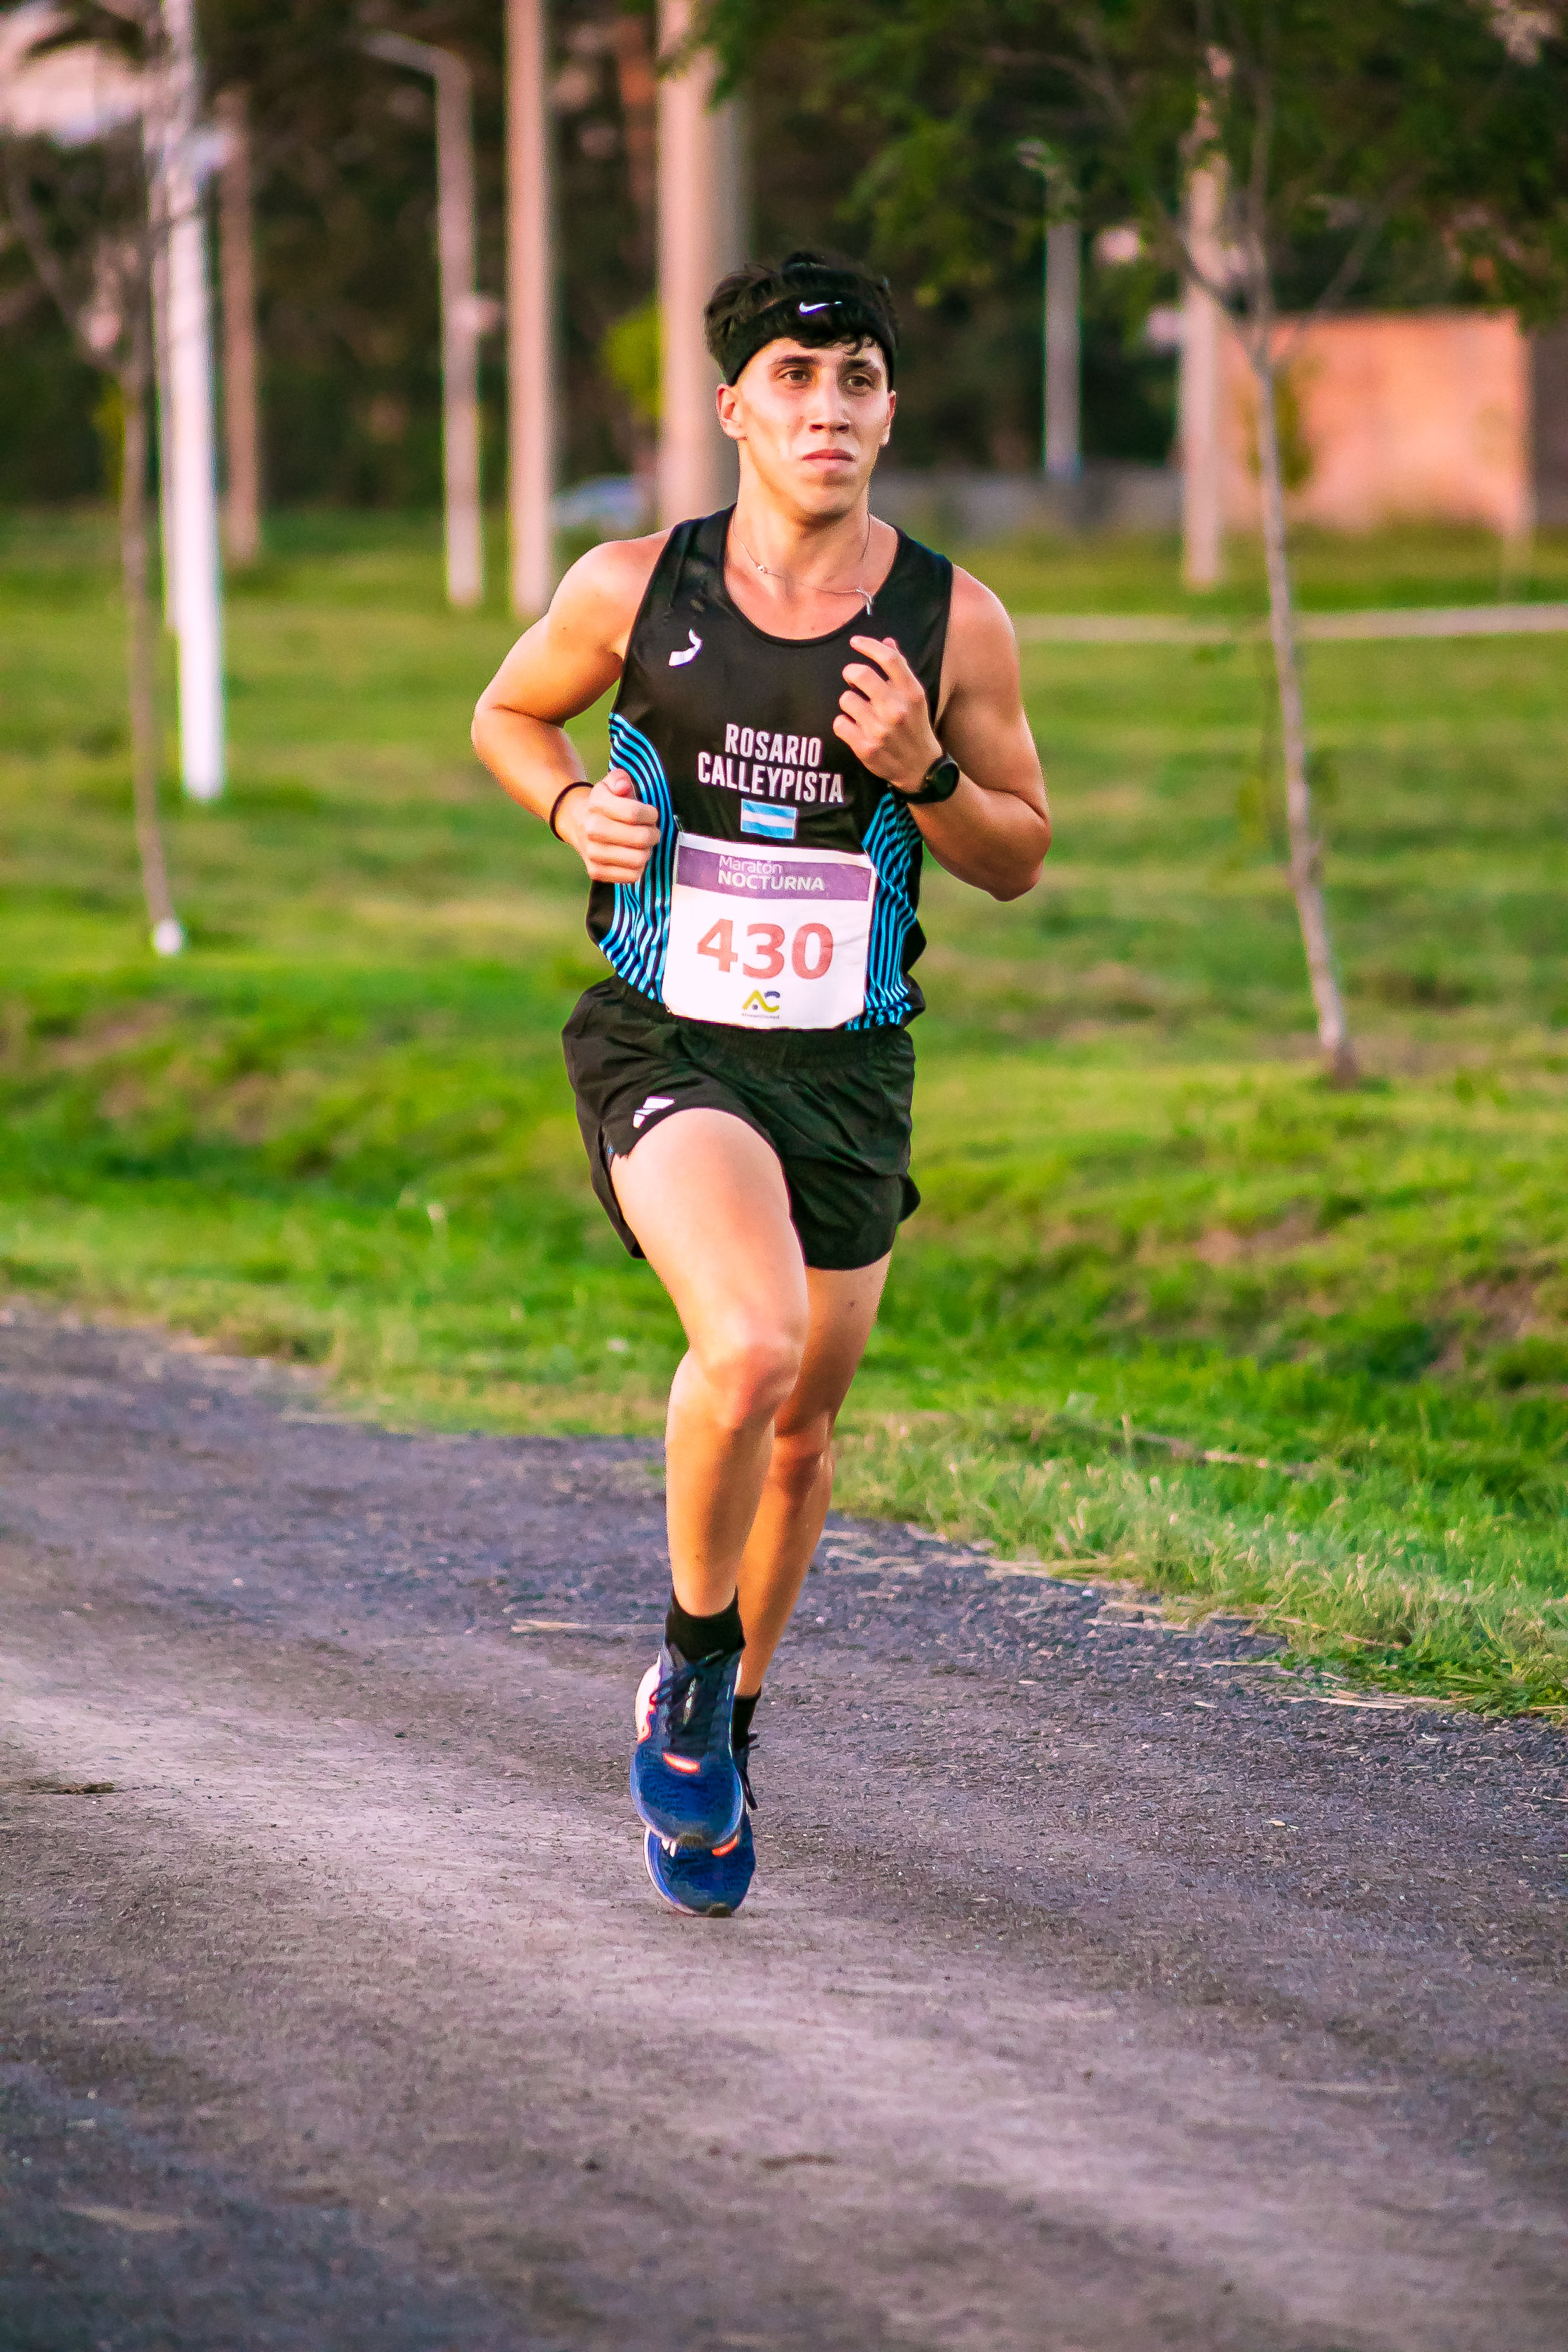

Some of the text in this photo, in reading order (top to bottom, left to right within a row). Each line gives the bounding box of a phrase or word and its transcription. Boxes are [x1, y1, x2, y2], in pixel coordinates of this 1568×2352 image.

[725, 723, 822, 767] ROSARIO
[697, 752, 844, 803] CALLEYPISTA
[718, 869, 825, 892] NOCTURNA
[719, 855, 783, 874] Maratón
[696, 918, 834, 979] 430
